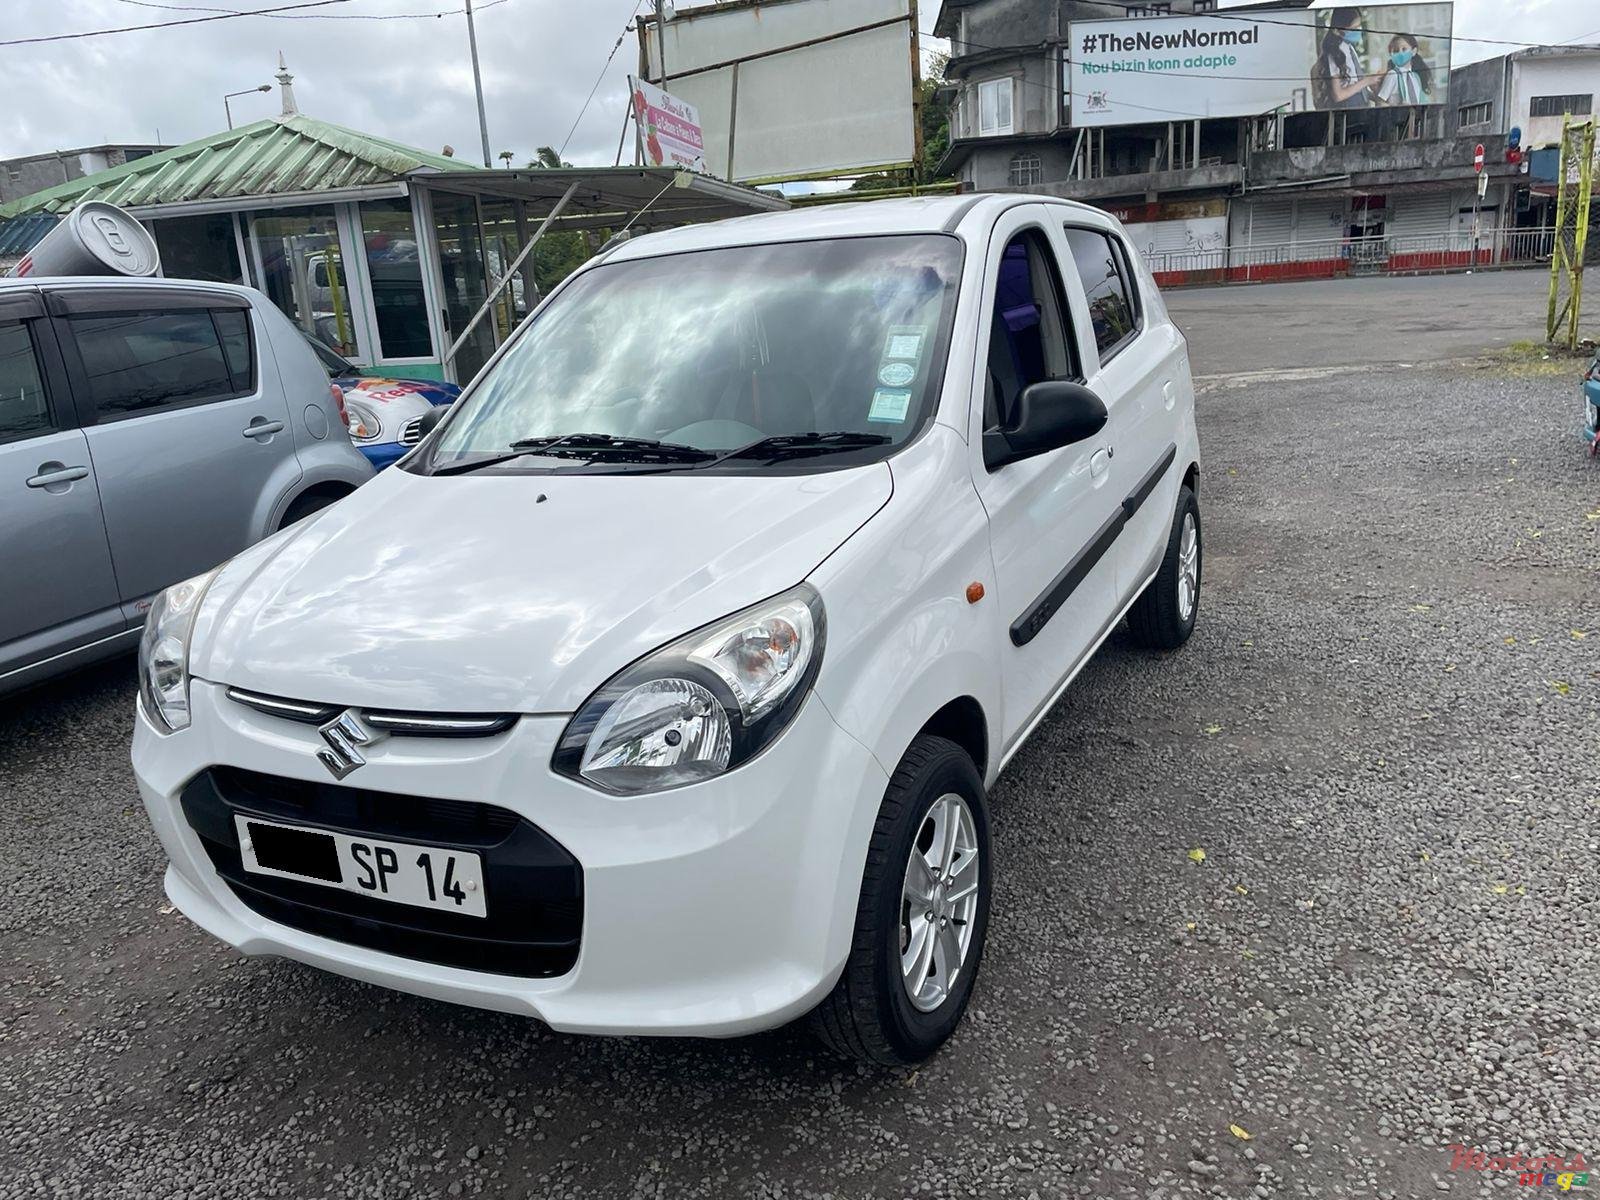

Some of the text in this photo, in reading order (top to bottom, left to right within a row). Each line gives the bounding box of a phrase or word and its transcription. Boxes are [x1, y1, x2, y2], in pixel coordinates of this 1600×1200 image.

[1082, 25, 1258, 53] #TheNewNormal
[1082, 54, 1237, 75] Nou bizin konn adapte
[350, 842, 467, 906] SP 14
